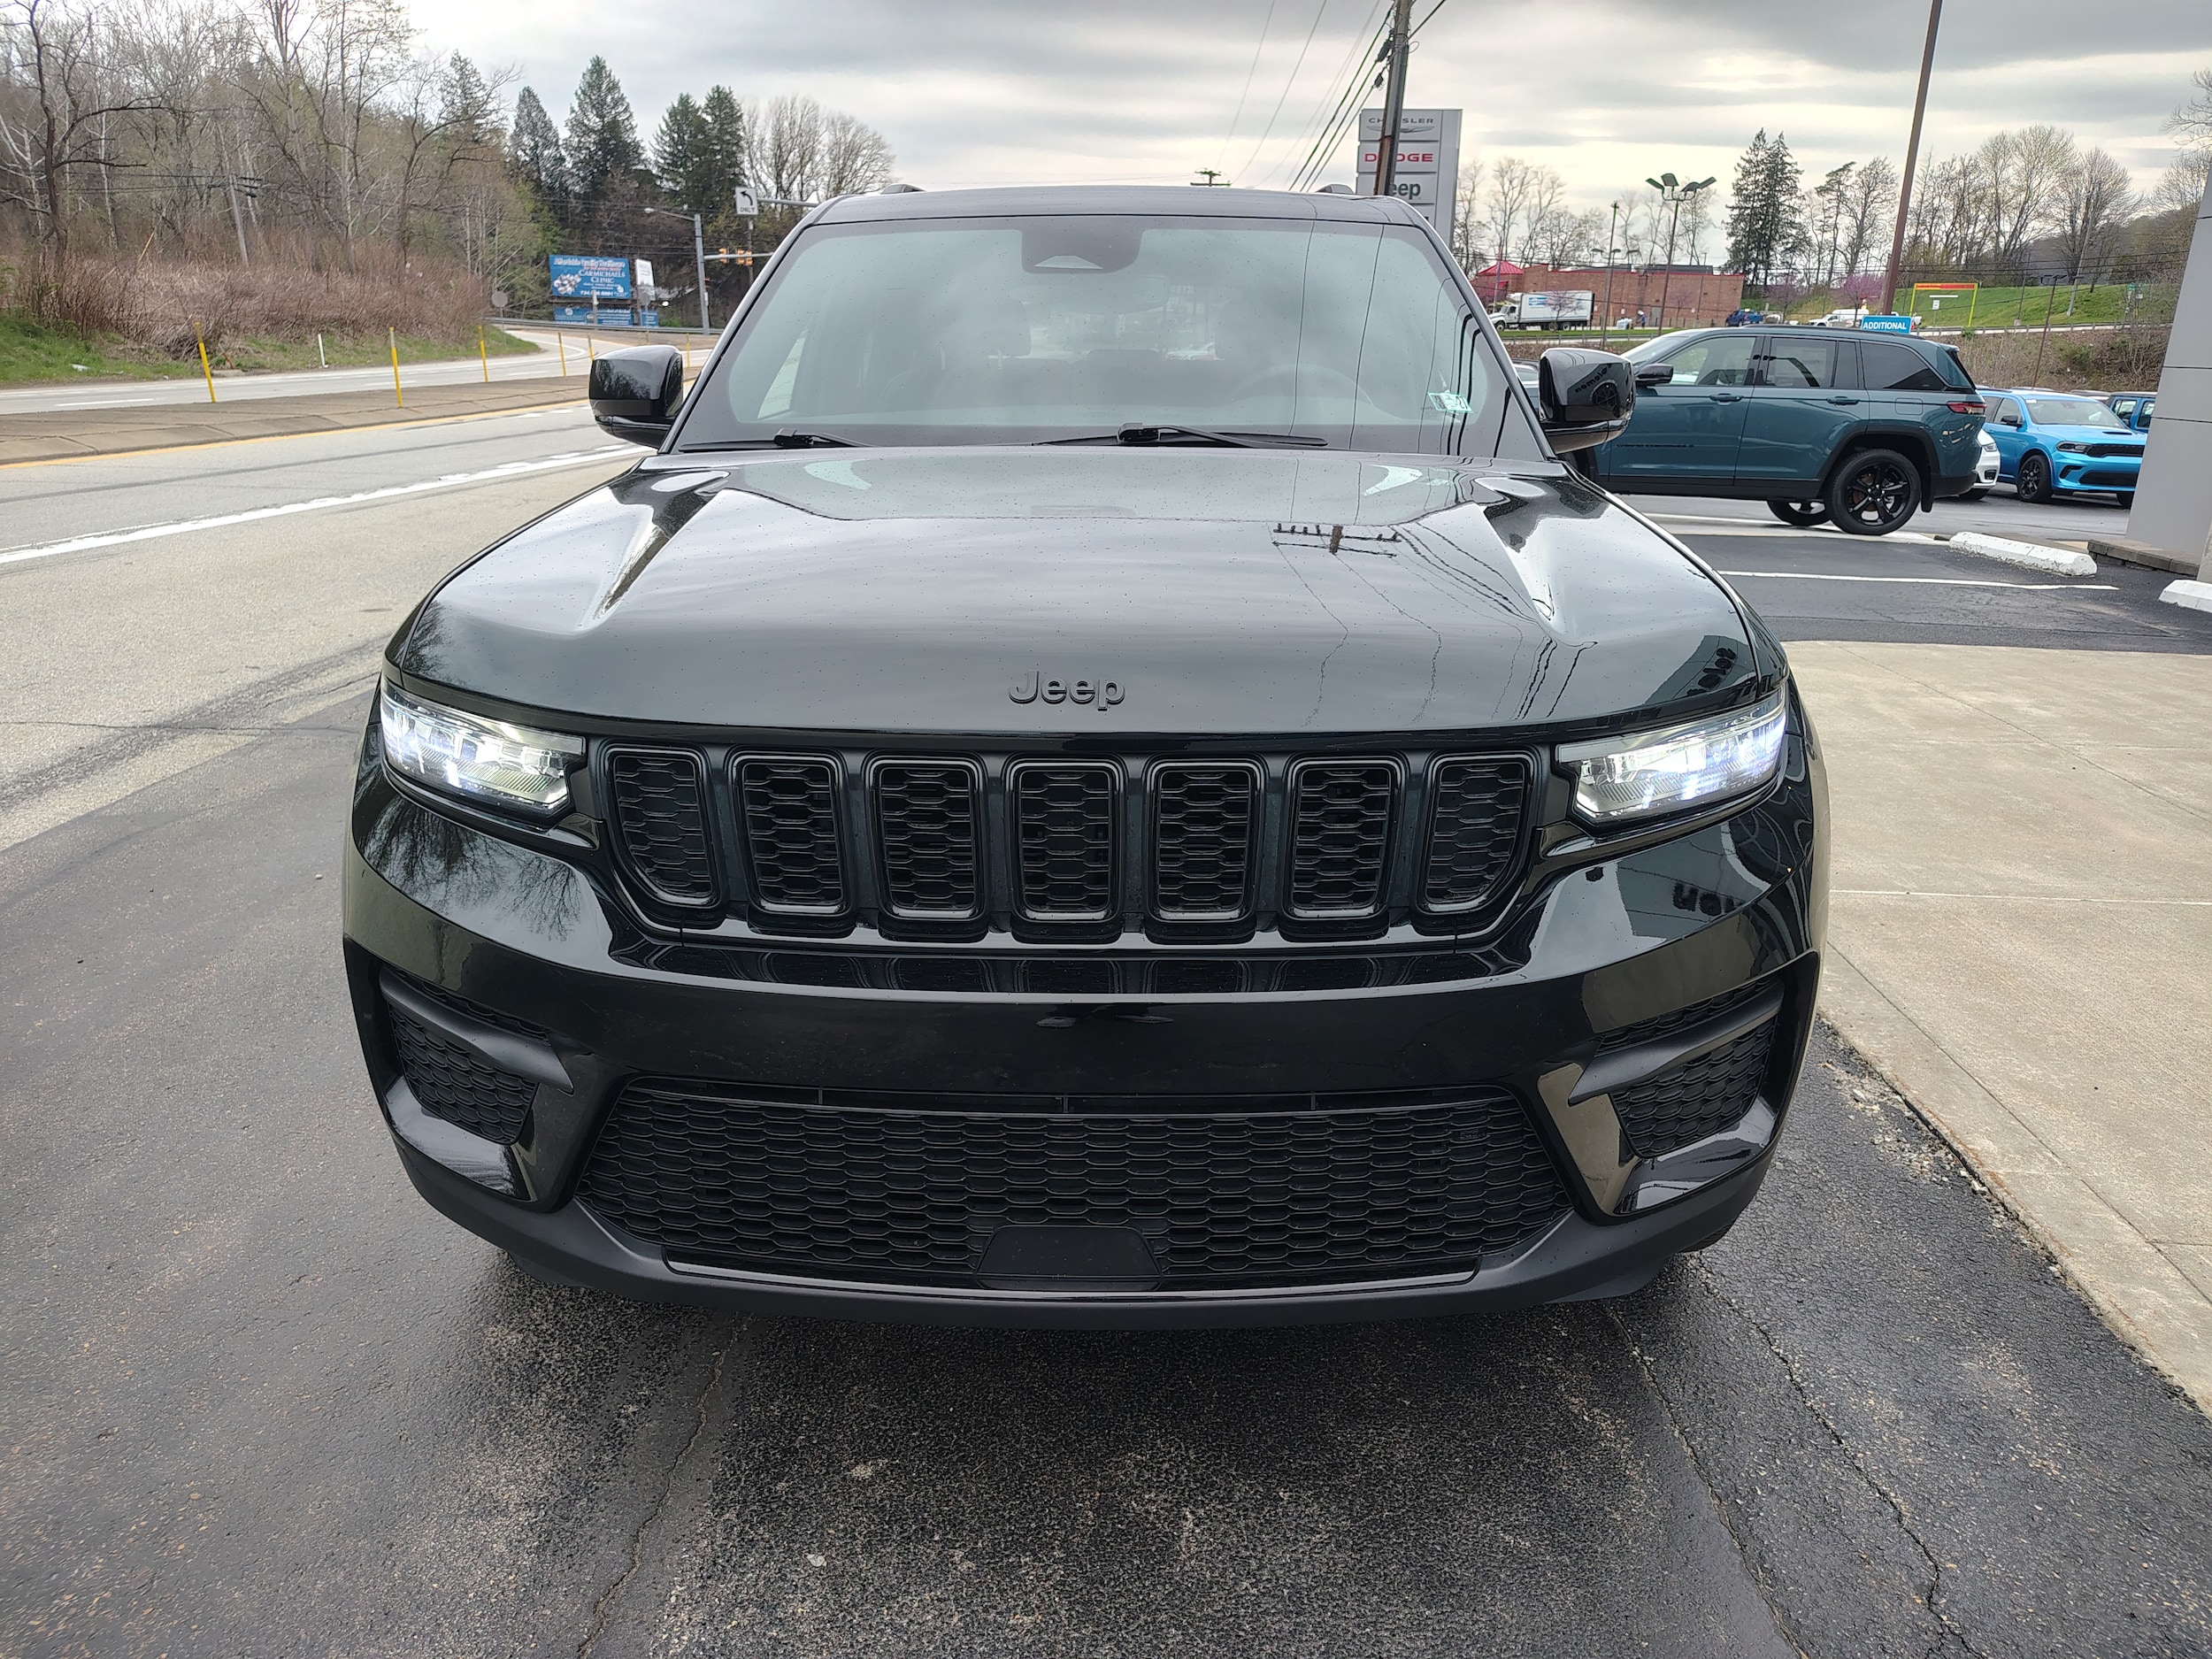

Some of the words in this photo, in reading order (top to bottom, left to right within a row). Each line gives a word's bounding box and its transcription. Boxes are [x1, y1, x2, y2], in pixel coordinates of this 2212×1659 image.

[1364, 153, 1434, 162] DDGE
[1863, 321, 1907, 330] ADDITIONAL
[1008, 669, 1125, 711] Jeep
